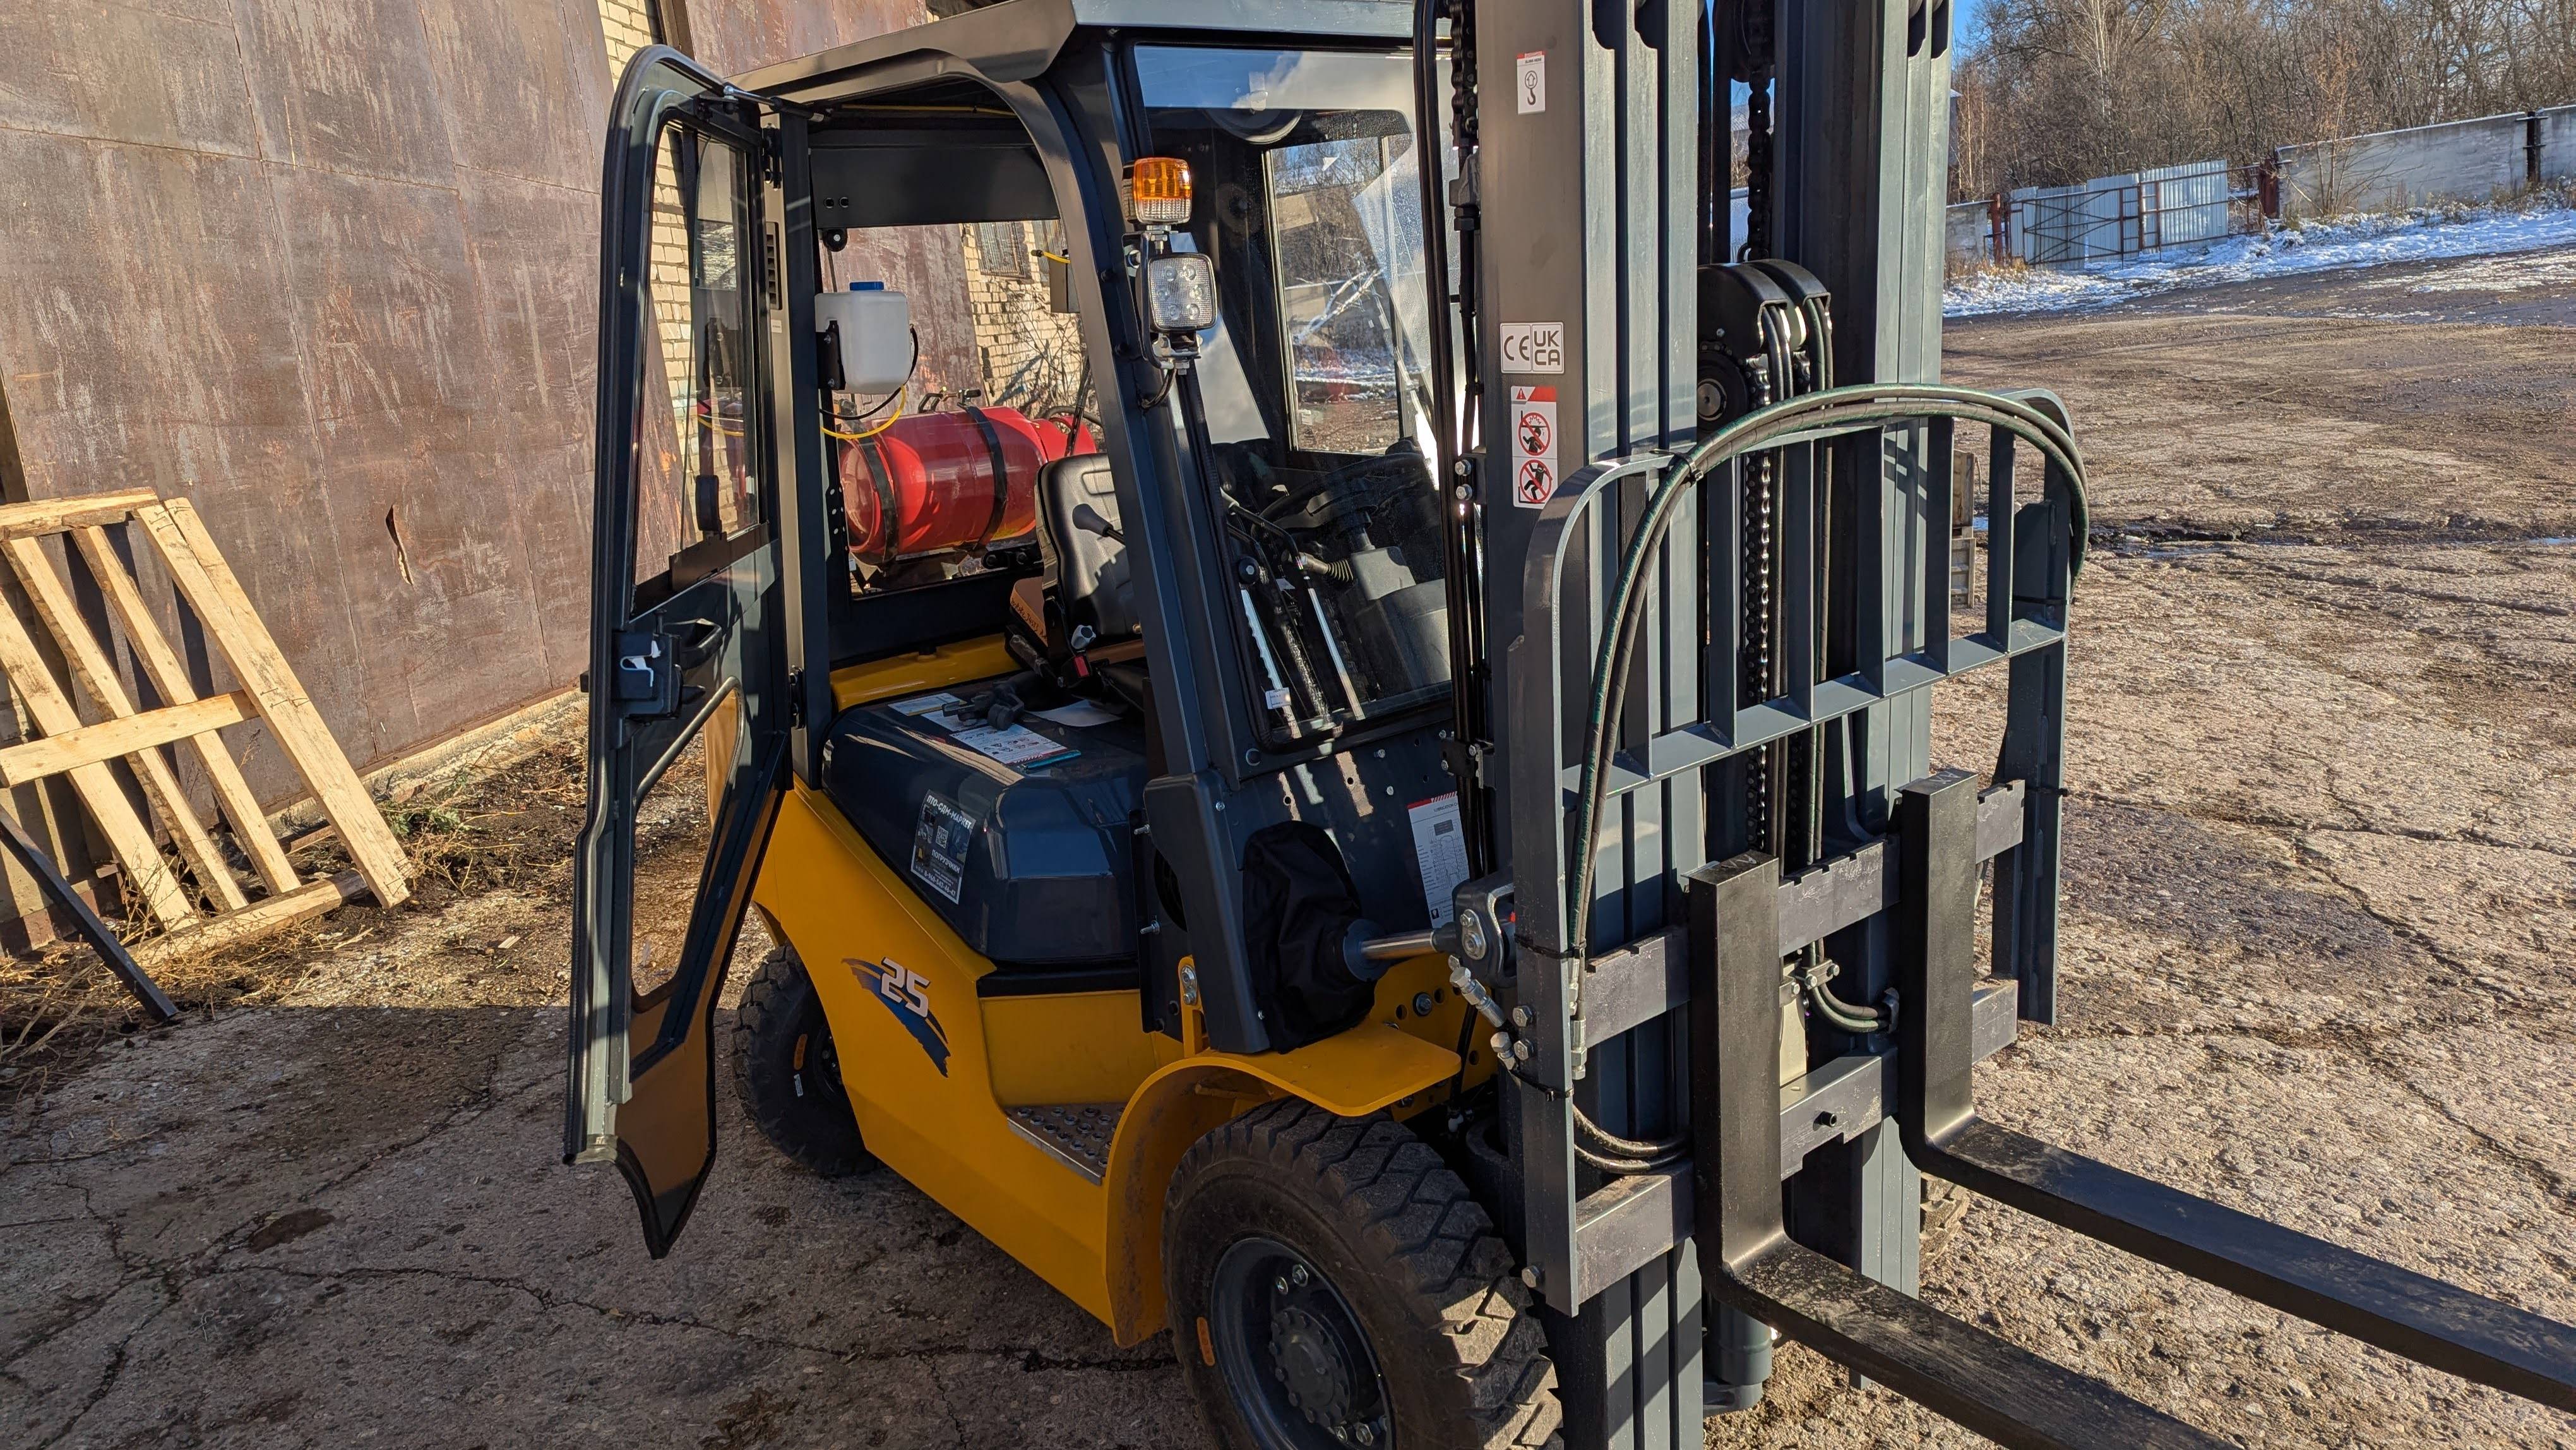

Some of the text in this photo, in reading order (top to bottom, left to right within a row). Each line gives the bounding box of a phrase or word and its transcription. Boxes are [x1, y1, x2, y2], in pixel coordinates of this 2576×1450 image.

[1503, 335, 1530, 361] CE
[1534, 330, 1560, 347] UK
[1534, 349, 1561, 366] CA
[926, 794, 972, 829] ПТО-СДМ-МАРКЕТ
[931, 849, 960, 873] ПОГРУЗЧИКИ
[880, 956, 931, 1018] 25
